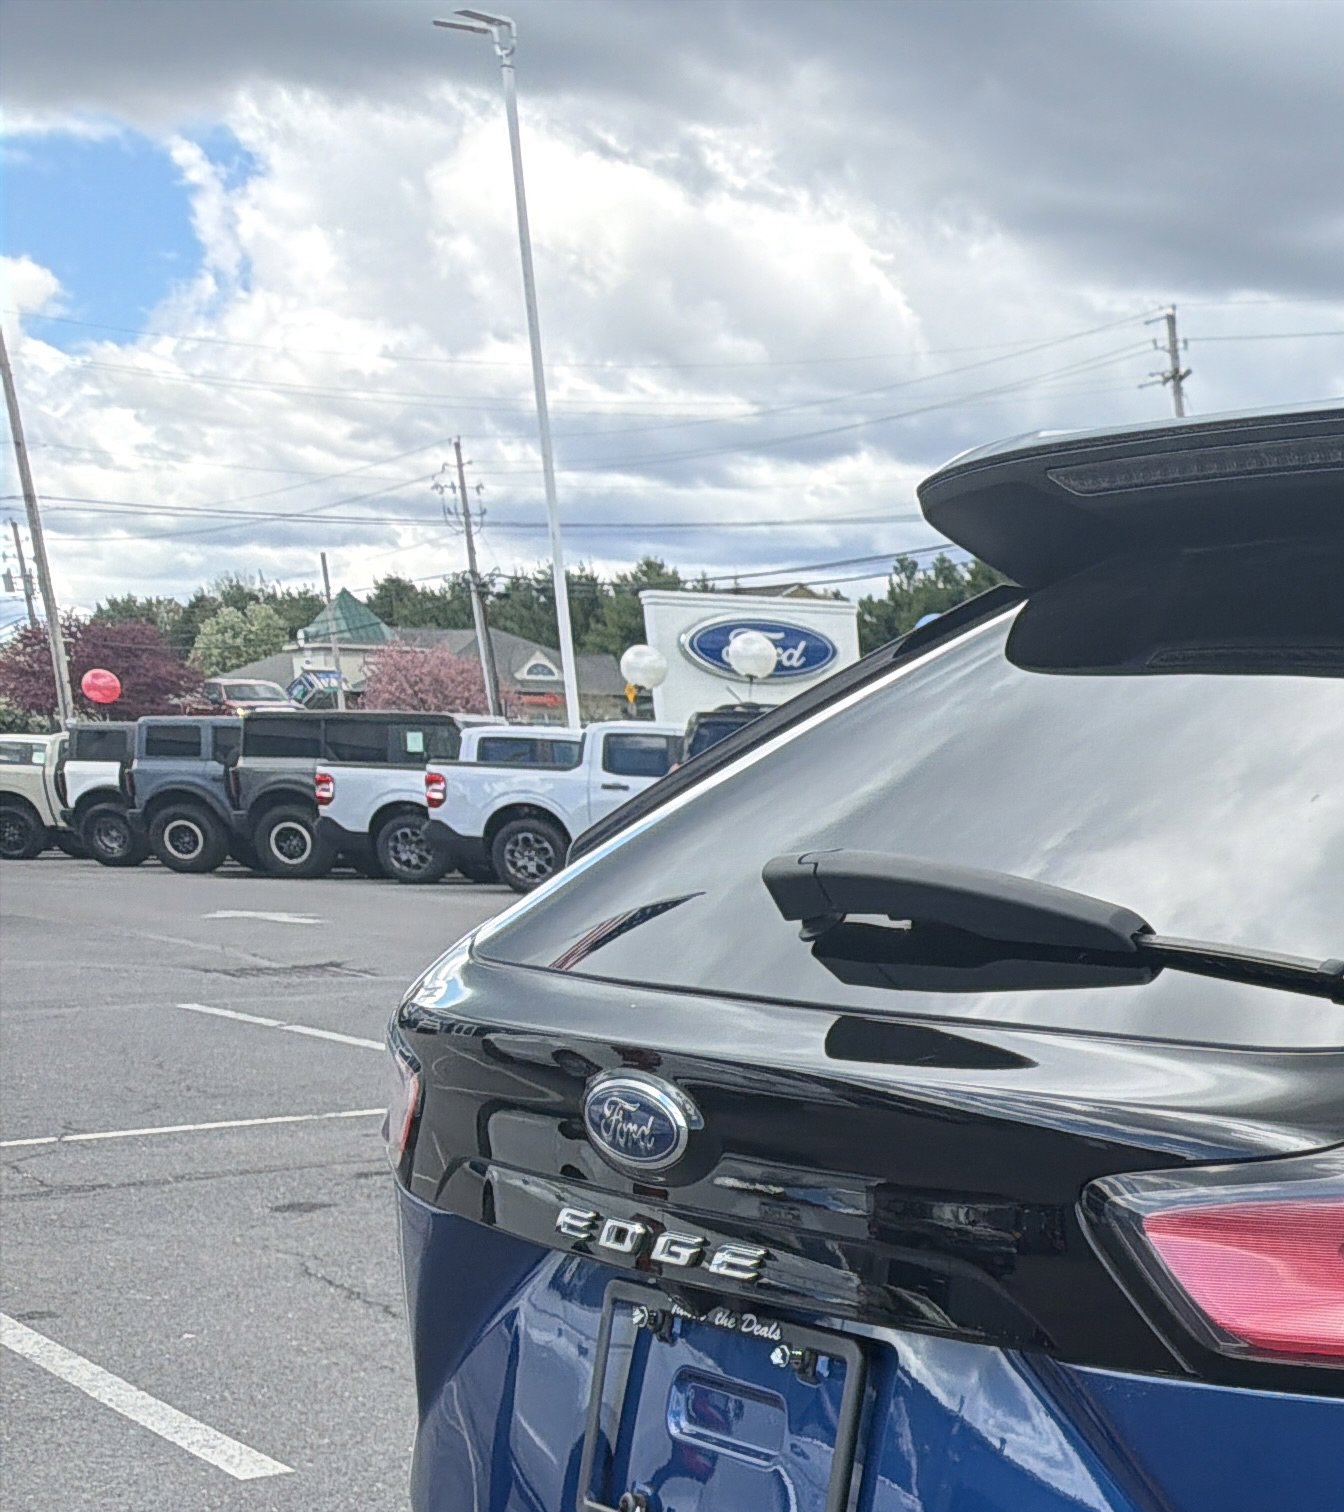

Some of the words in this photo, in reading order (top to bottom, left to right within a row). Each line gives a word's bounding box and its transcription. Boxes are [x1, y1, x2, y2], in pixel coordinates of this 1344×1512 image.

[600, 1096, 656, 1149] Ford
[555, 1206, 770, 1281] EDGE
[714, 1311, 737, 1329] the
[741, 1313, 781, 1341] Deals
